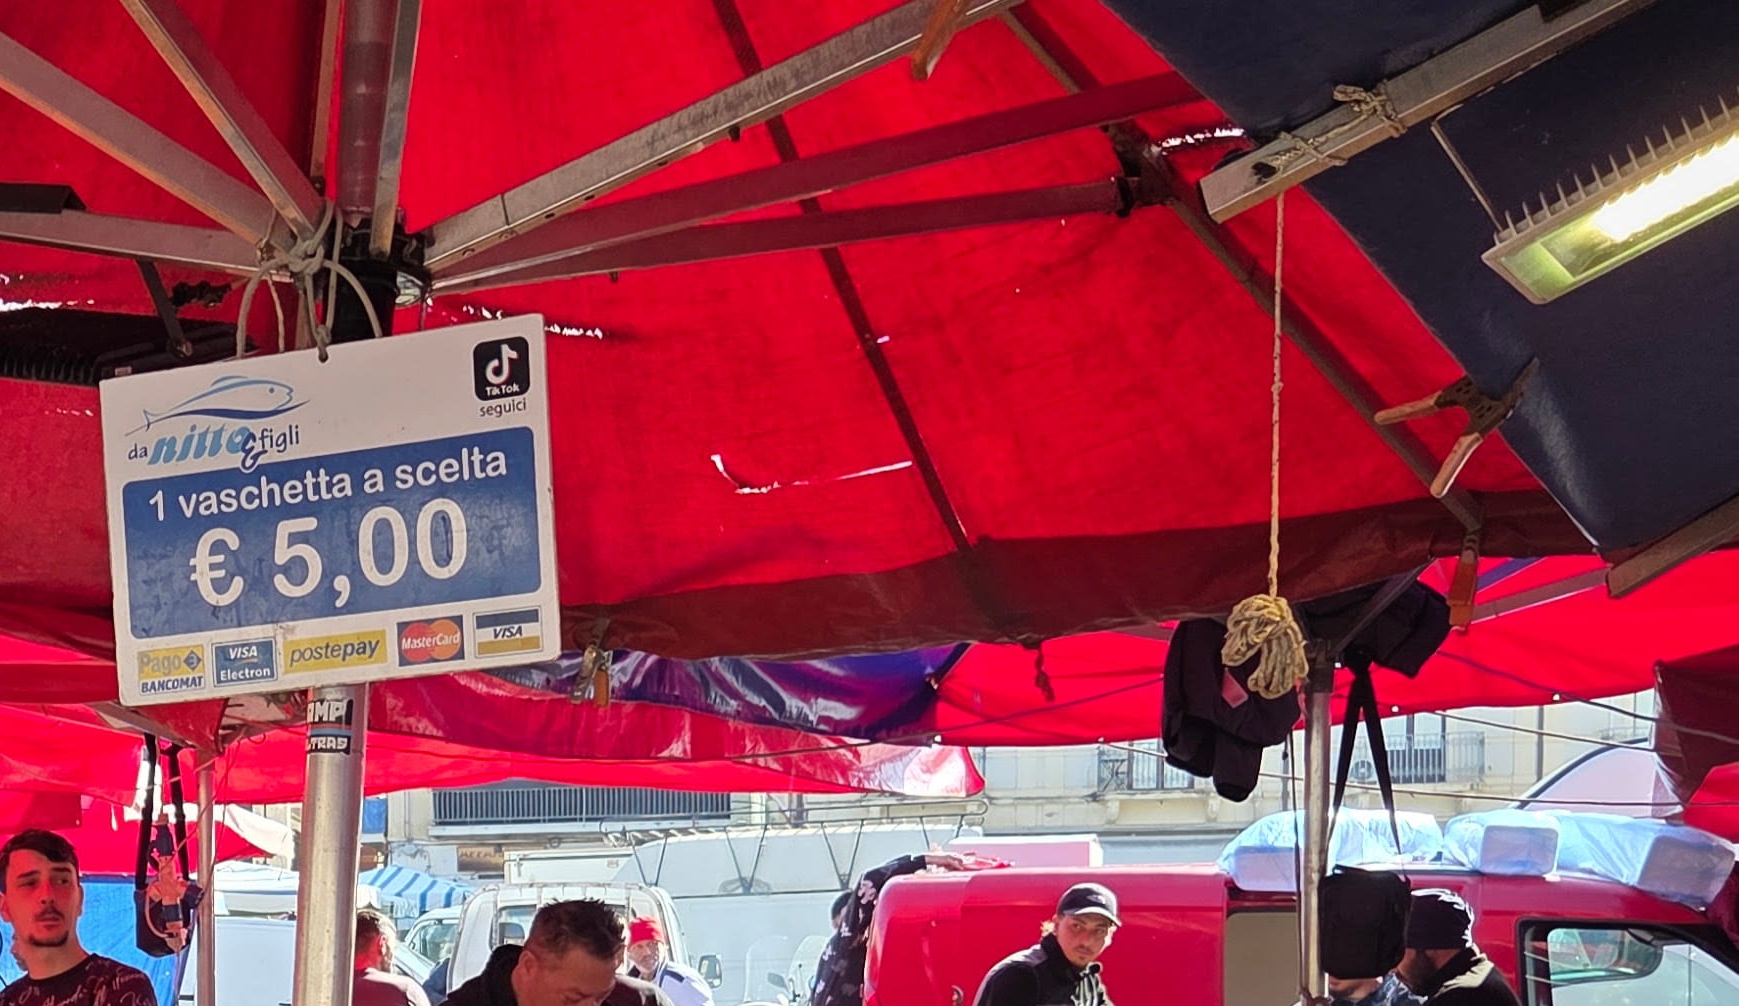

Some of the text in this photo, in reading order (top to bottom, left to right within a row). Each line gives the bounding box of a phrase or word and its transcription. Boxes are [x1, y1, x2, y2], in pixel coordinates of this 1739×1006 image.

[485, 382, 520, 397] TikTok
[479, 397, 527, 418] seguici
[127, 442, 148, 460] da
[259, 424, 300, 453] figli
[148, 446, 508, 522] 1 vaschetta a scelta
[189, 498, 468, 608] € 5,00
[401, 631, 460, 650] MasterCard
[492, 626, 523, 640] VISA
[228, 645, 258, 660] VISA
[289, 639, 380, 667] postepay
[139, 652, 182, 676] Pago
[141, 676, 204, 693] BANCOMAT
[220, 668, 272, 682] Electron
